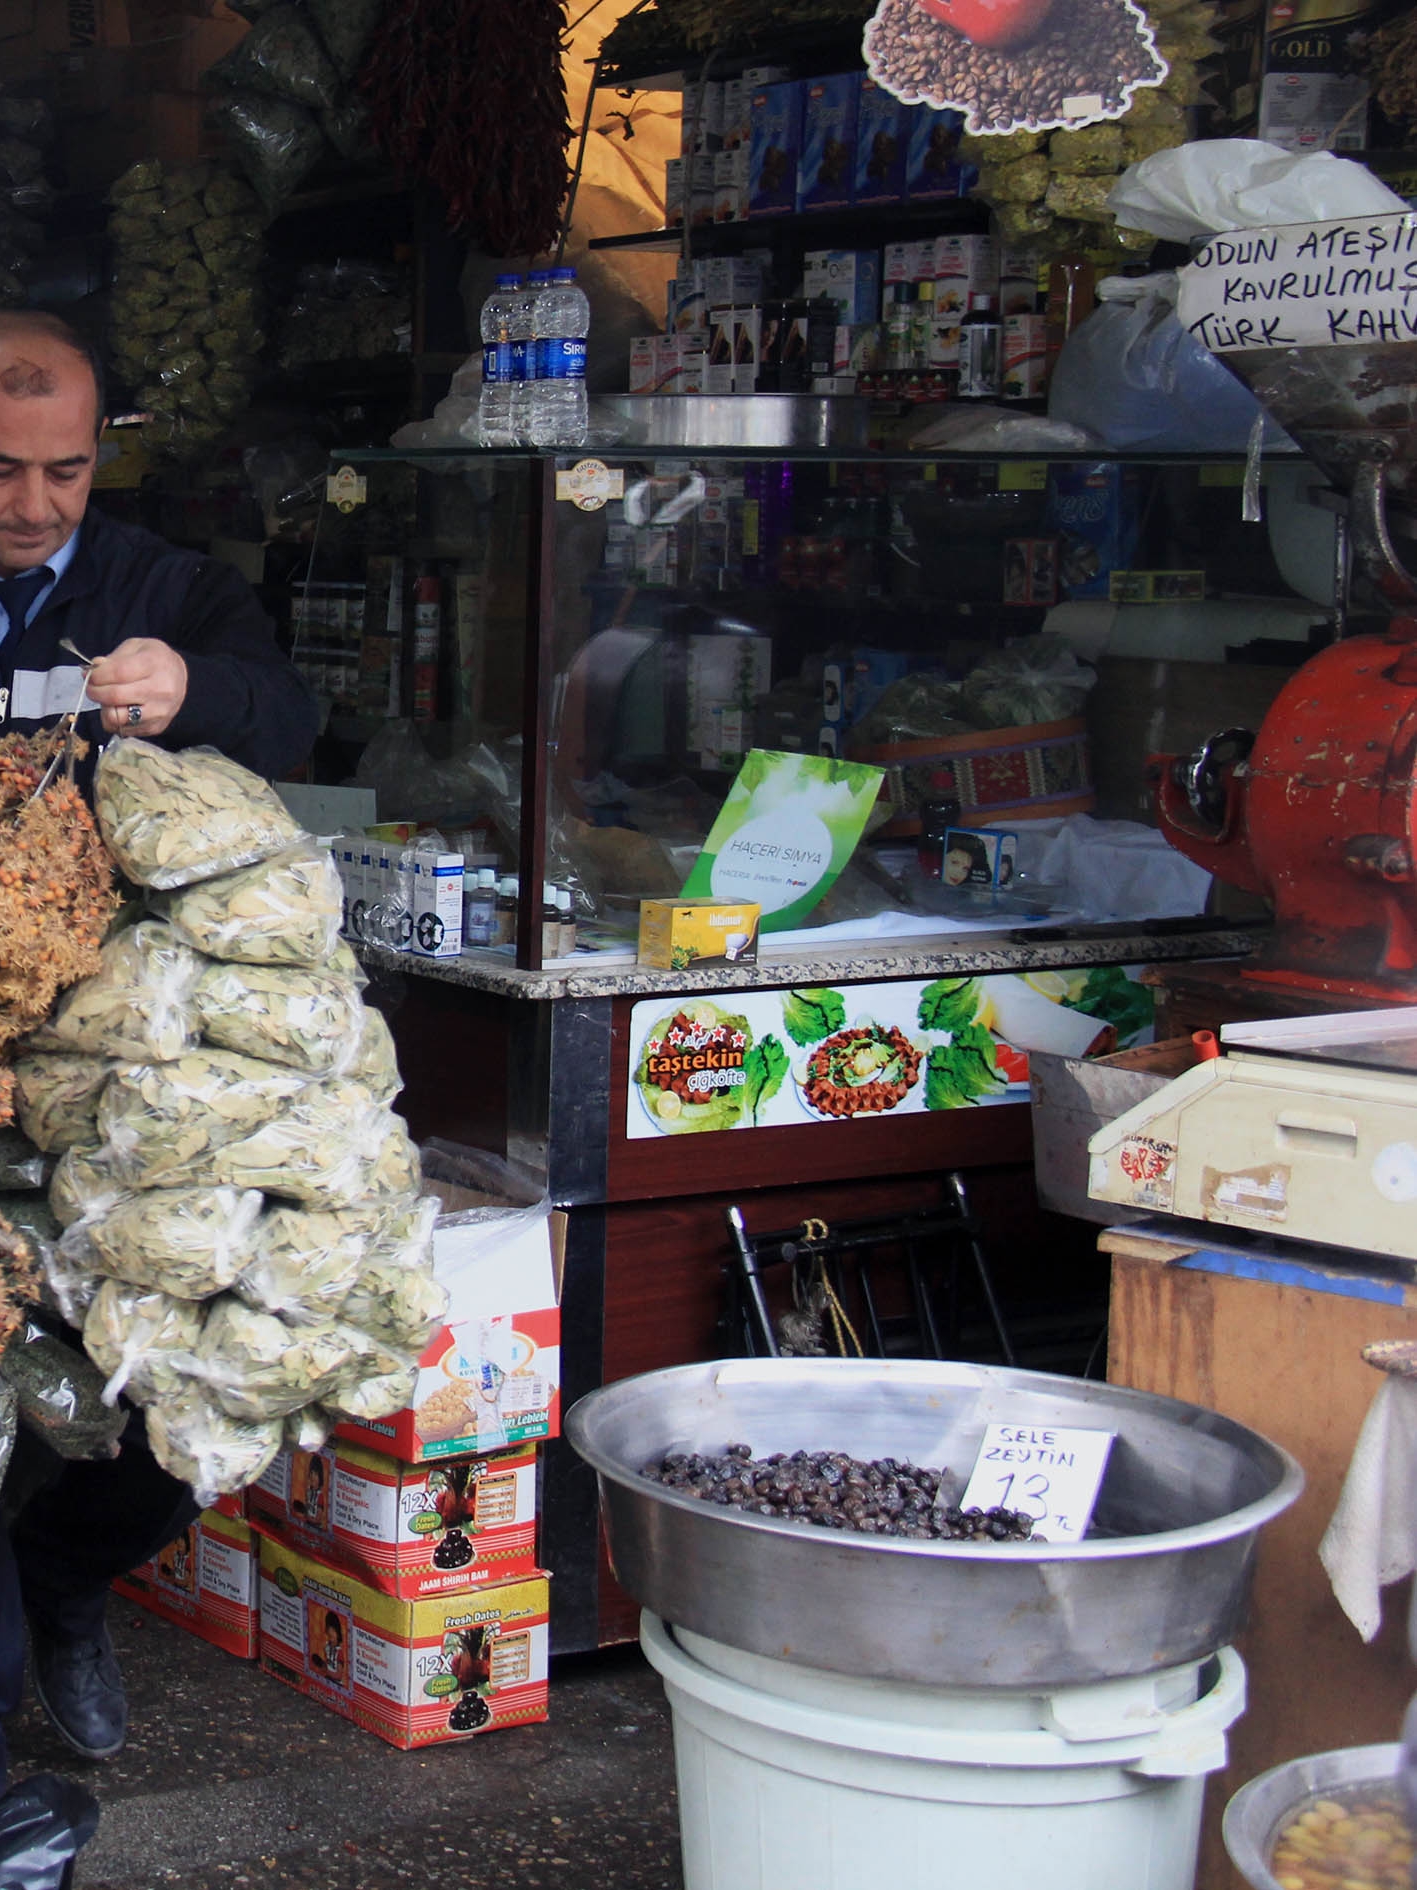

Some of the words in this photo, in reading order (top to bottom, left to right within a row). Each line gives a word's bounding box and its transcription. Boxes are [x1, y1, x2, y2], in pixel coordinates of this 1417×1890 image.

[1271, 41, 1331, 58] GOLD
[1194, 237, 1277, 268] ODUN
[1189, 313, 1296, 348] TÜRK
[648, 1048, 743, 1076] taştekin
[998, 1428, 1057, 1445] SELE
[401, 1489, 439, 1514] 12X
[996, 1473, 1050, 1521] 13
[1055, 1515, 1075, 1532] TL
[418, 1578, 441, 1591] JAAM
[442, 1573, 470, 1587] SHIRIN
[471, 1569, 489, 1582] BAM
[445, 1612, 473, 1628] Fresh
[474, 1608, 501, 1622] Dates
[417, 1653, 454, 1678] 12X
